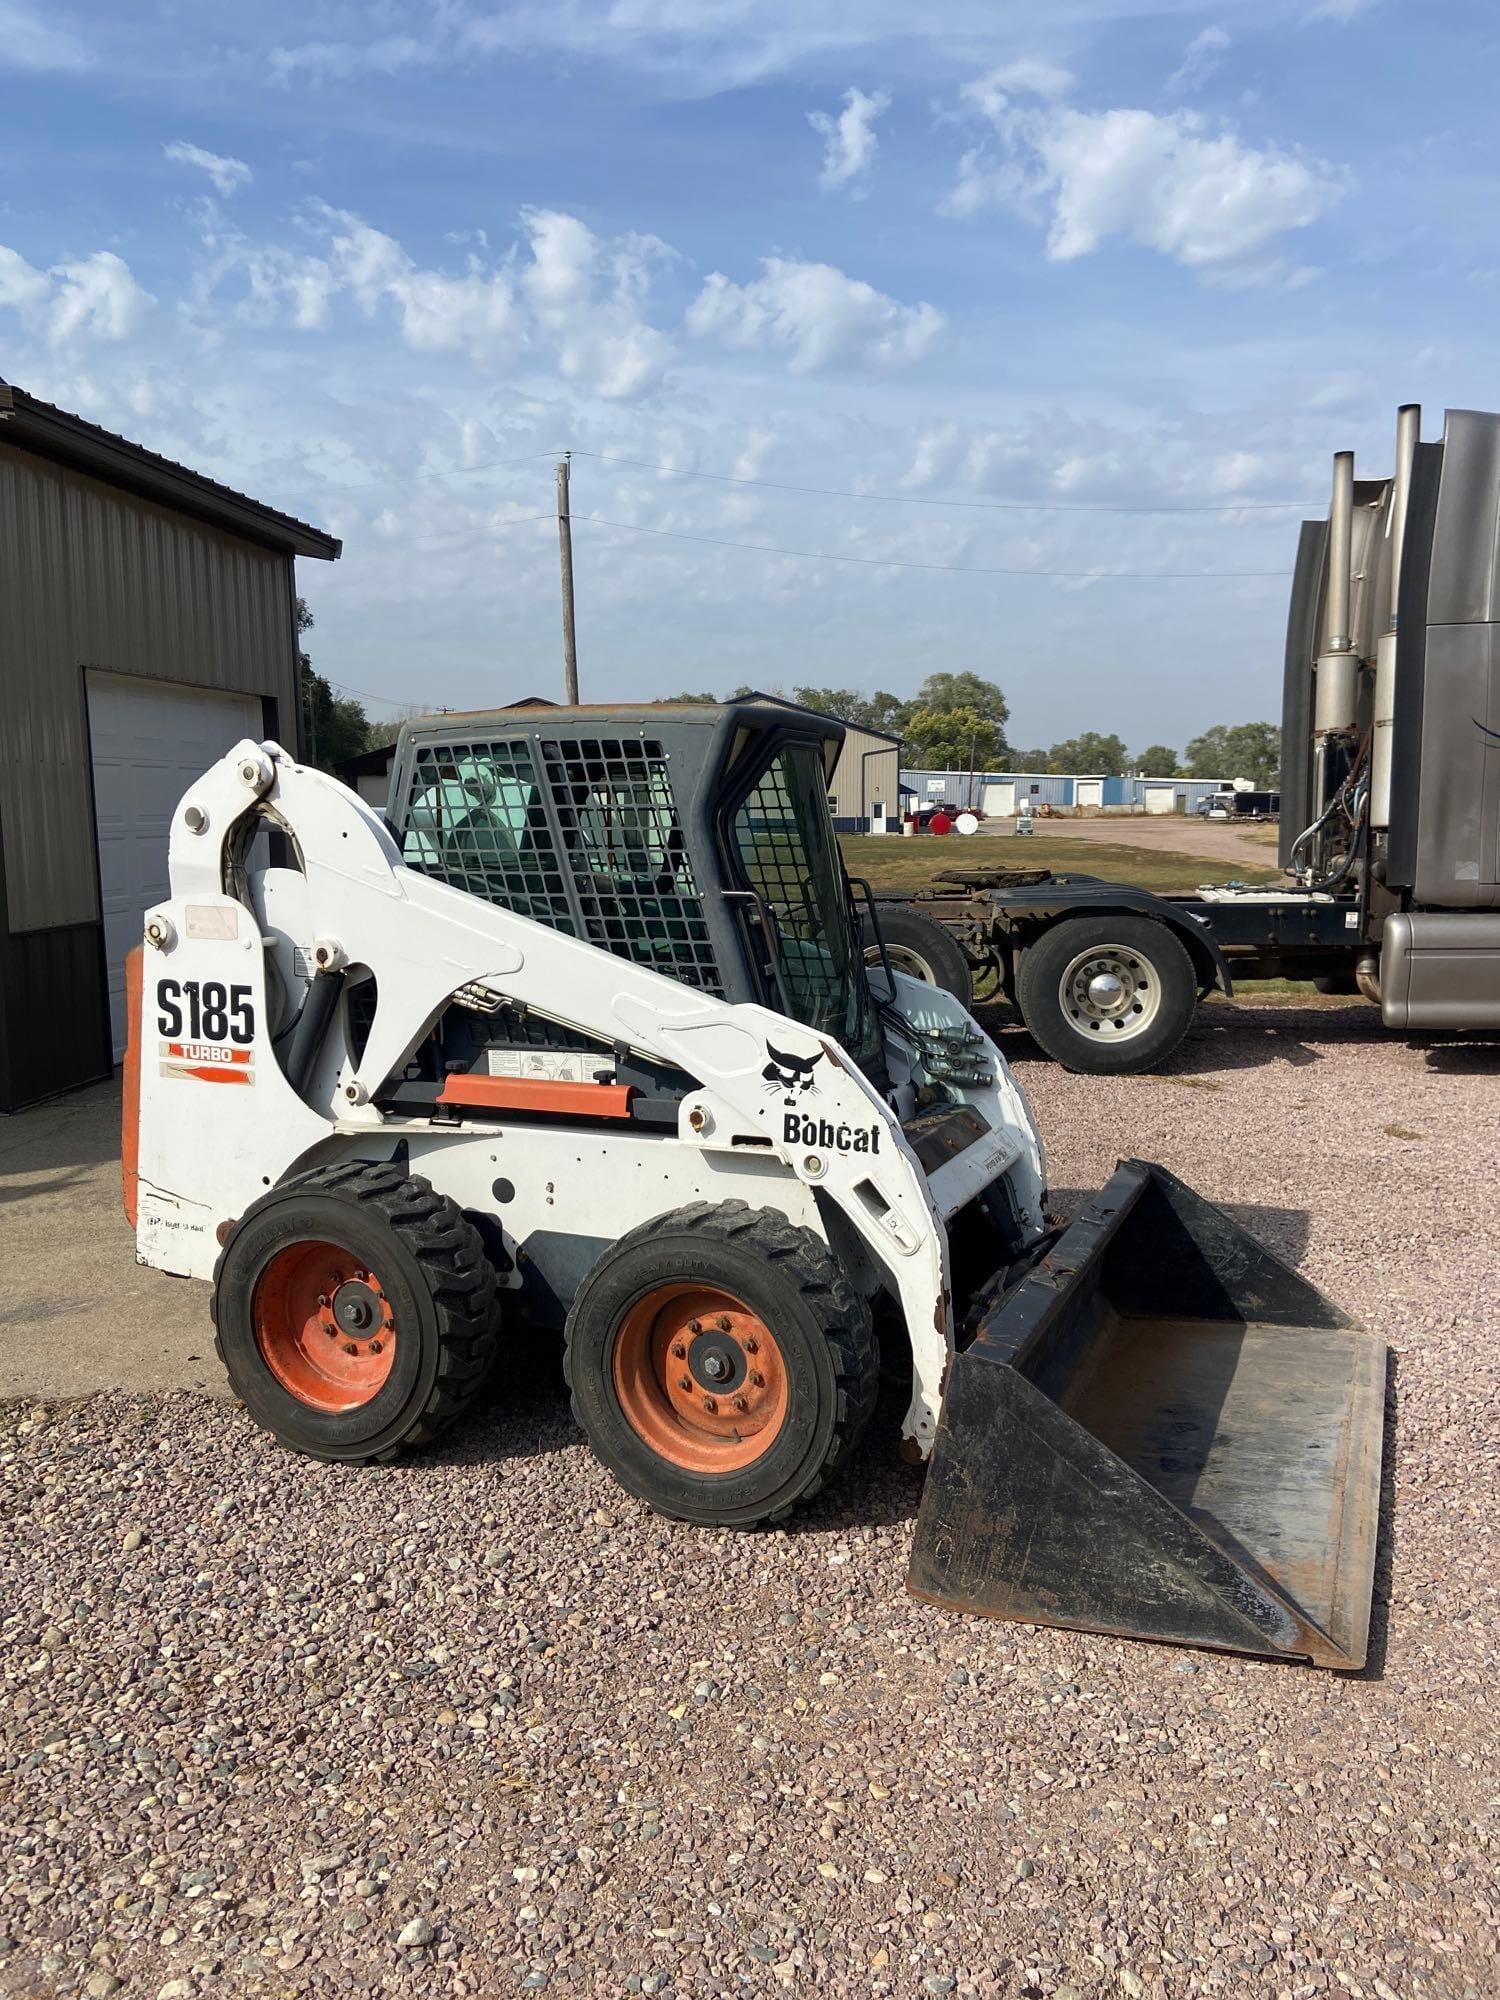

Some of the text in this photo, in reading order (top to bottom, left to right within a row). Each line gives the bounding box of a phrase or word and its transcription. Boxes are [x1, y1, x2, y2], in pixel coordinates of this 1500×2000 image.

[157, 979, 255, 1044] S185
[180, 1044, 232, 1063] TURBO
[783, 1113, 880, 1154] Bobcat
